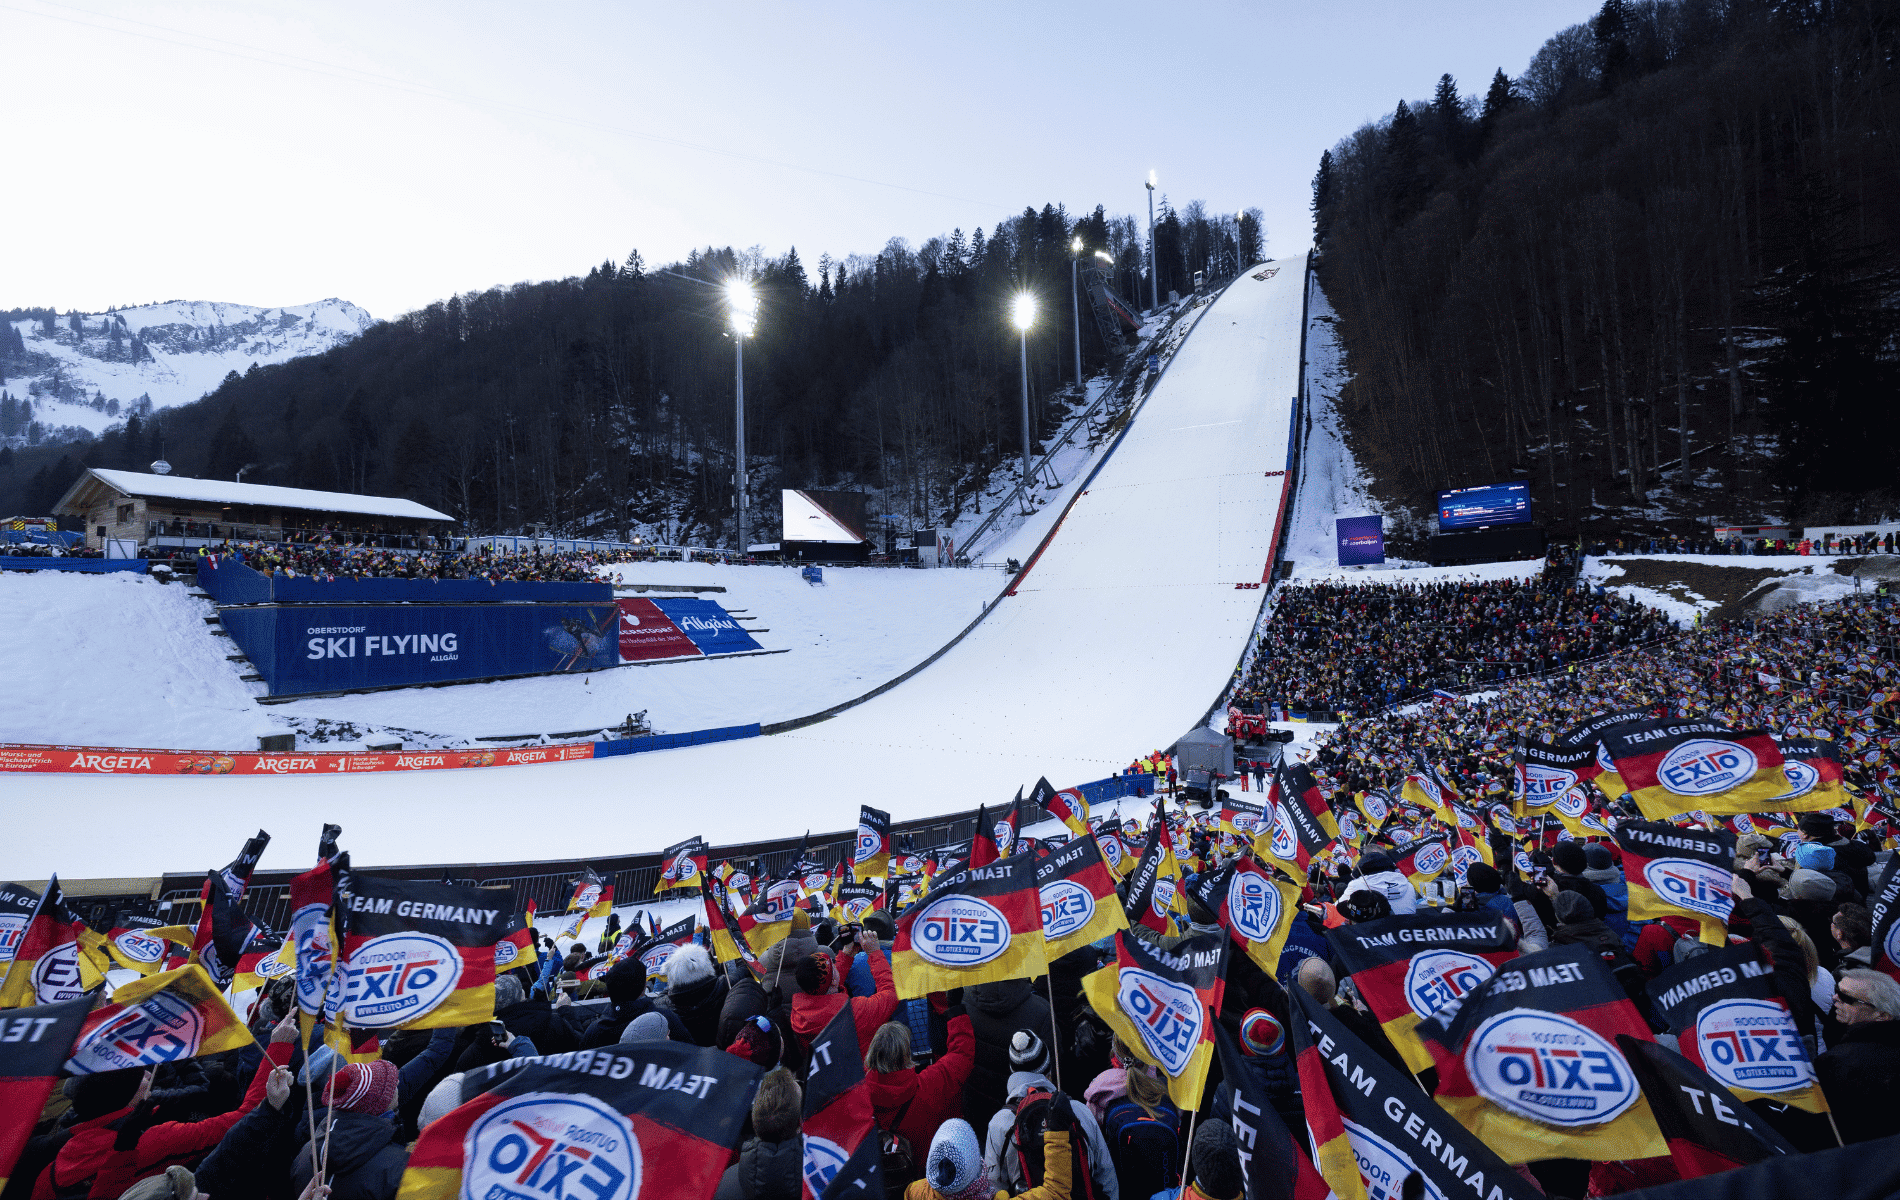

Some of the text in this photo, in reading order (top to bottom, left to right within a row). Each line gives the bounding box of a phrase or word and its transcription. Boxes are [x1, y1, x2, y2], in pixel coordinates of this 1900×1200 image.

[307, 626, 366, 634] OBERSTDORF
[306, 632, 458, 660] SKI FLYING
[430, 654, 458, 662] ALLGÄU
[1569, 712, 1645, 746] TEAM GERMANY
[1623, 726, 1666, 745] TEAM
[507, 751, 546, 763] ARGETA
[1530, 750, 1590, 764] GERMANY
[1780, 746, 1818, 755] MANY
[70, 752, 151, 772] ARGETA
[254, 757, 316, 773] ARGETA
[338, 758, 346, 771] 1
[395, 755, 444, 770] ARGETA
[1288, 796, 1322, 844] GERMANY
[0, 890, 14, 902] AM
[397, 900, 500, 926] GERMANY
[1356, 926, 1497, 949] TEAM GERMANY
[359, 952, 407, 965] OUTDOOR
[358, 996, 418, 1016] WWW.EXITO.AG
[1307, 1020, 1377, 1097] TEAM
[1352, 1148, 1391, 1186] DOOR
